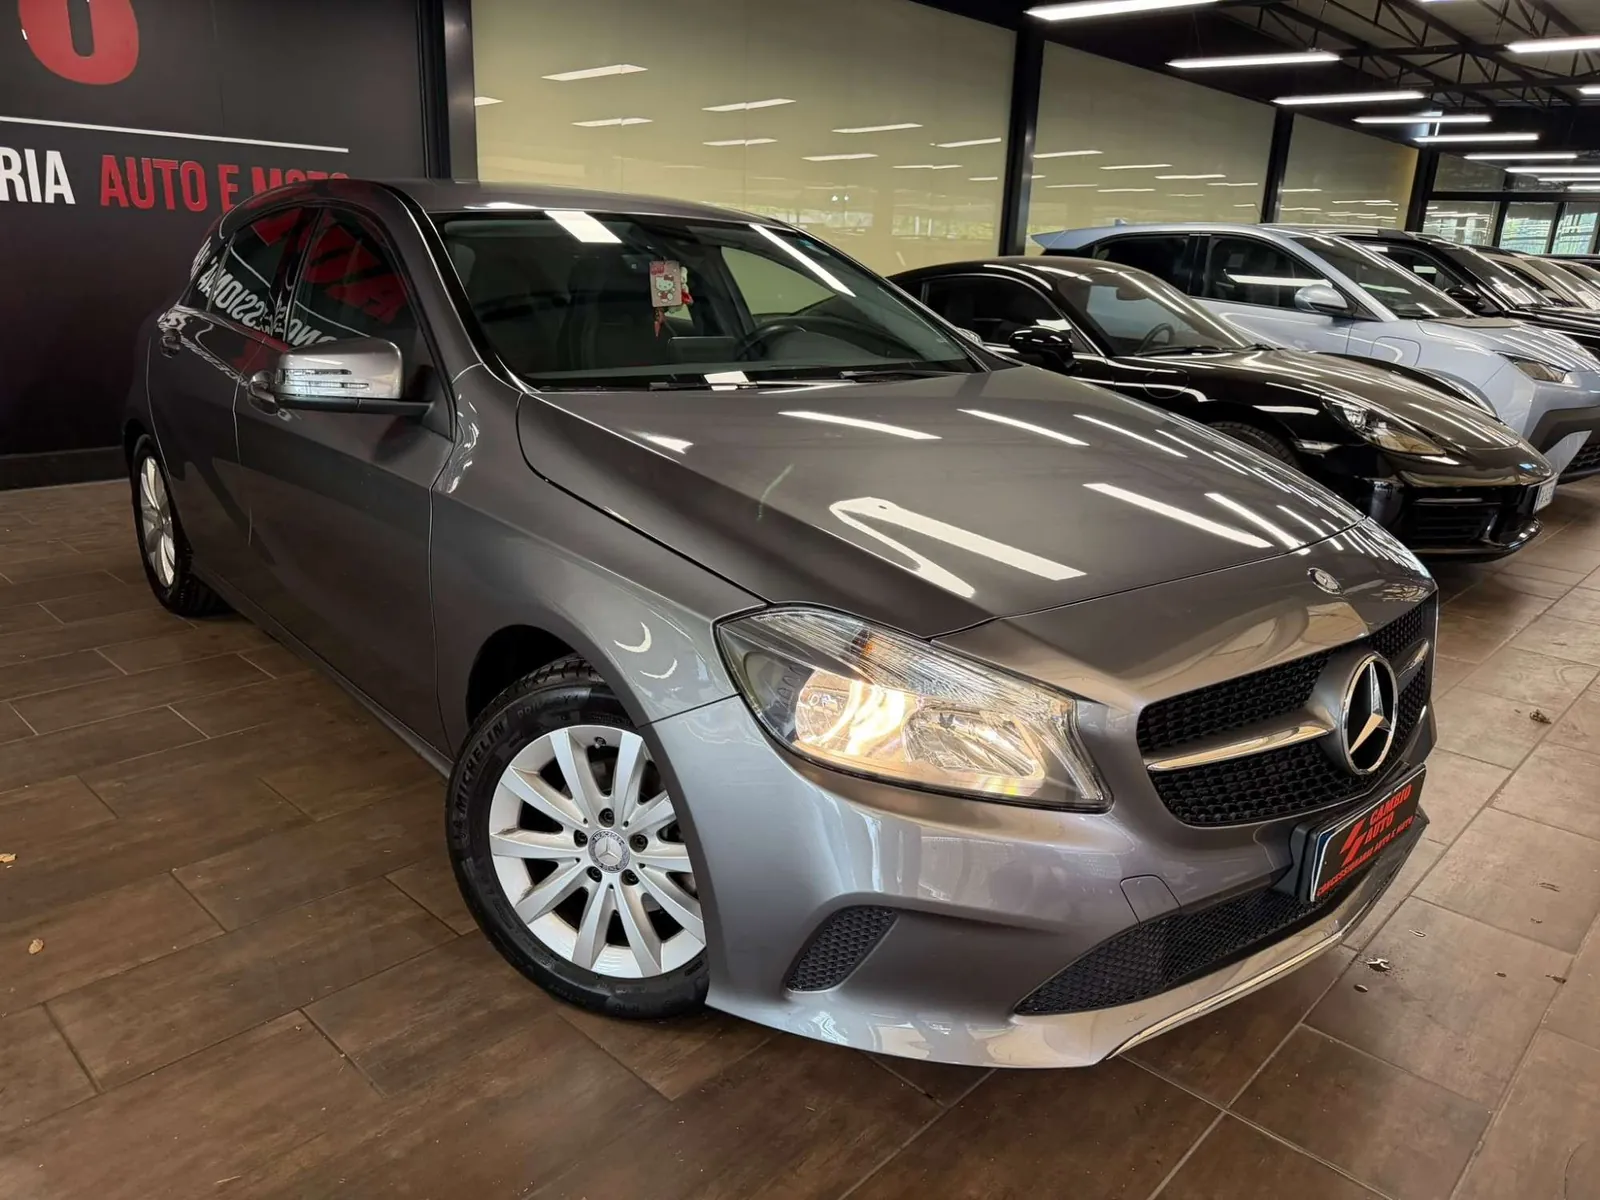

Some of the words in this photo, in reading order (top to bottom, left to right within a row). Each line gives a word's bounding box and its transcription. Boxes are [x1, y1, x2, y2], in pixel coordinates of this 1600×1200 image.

[100, 154, 207, 212] AUTO
[218, 163, 240, 213] E
[454, 720, 506, 814] MICHELIN
[1364, 811, 1395, 845] AUTO
[1370, 784, 1412, 825] CAMBIO
